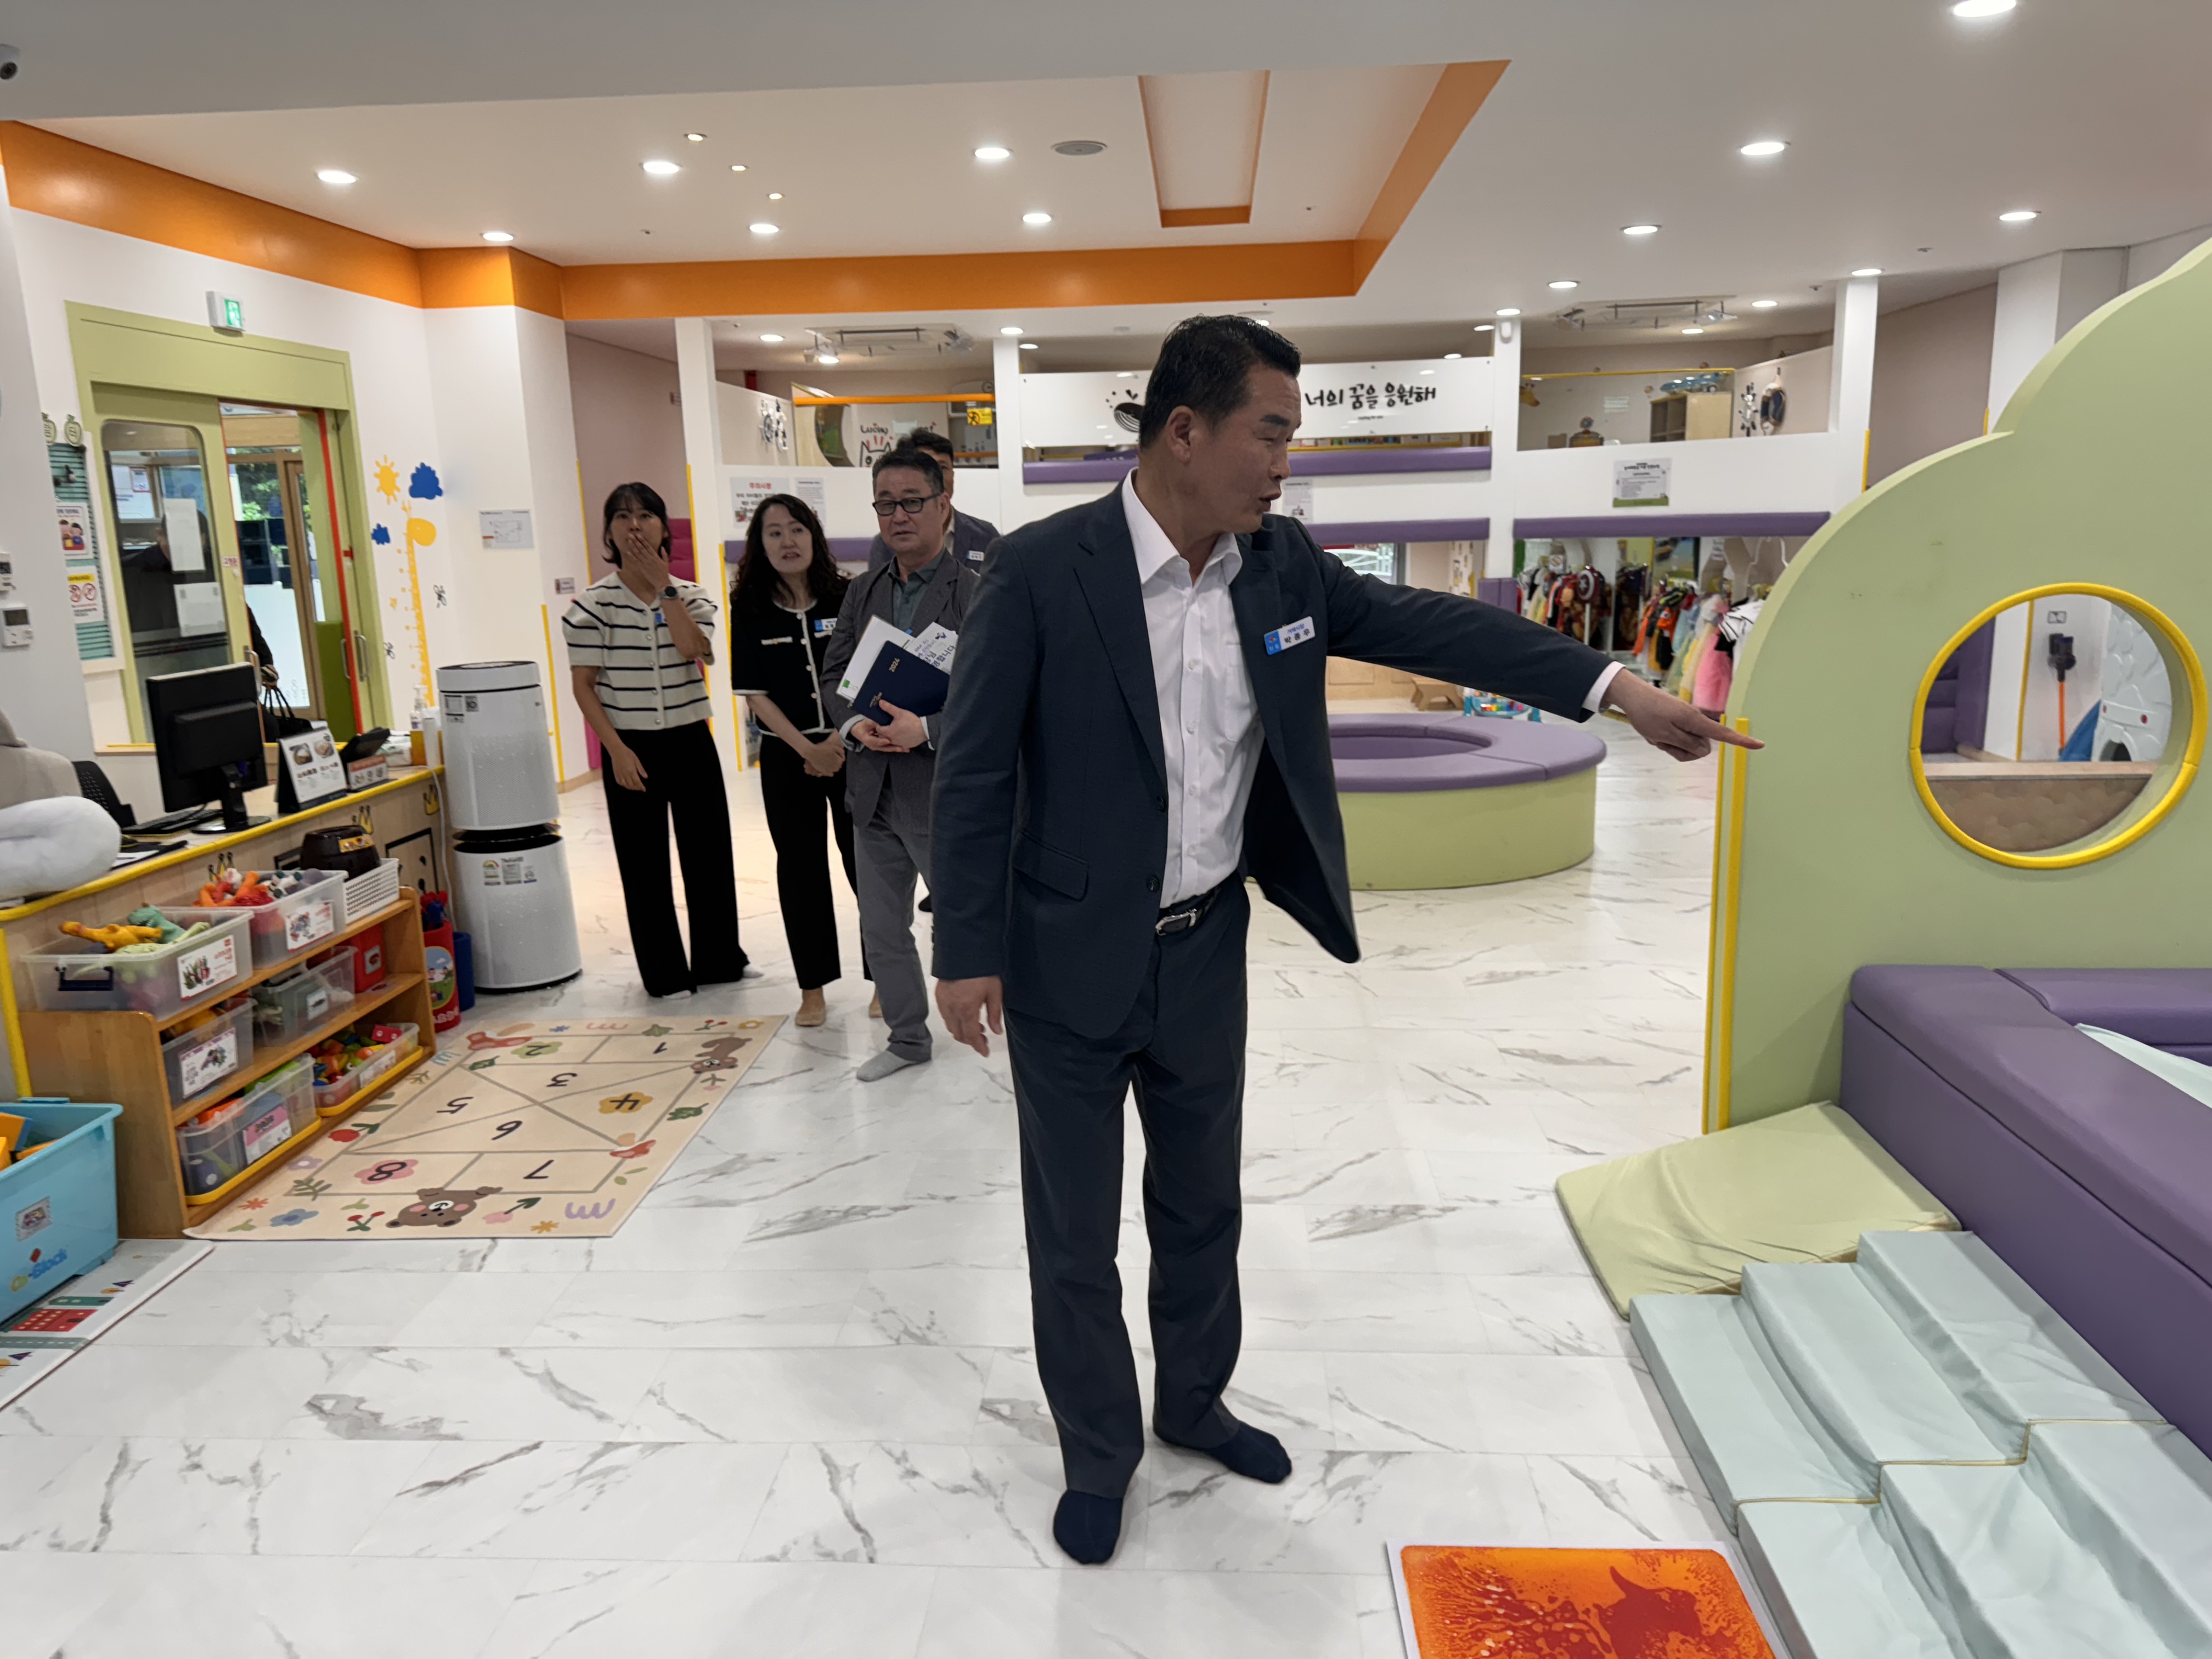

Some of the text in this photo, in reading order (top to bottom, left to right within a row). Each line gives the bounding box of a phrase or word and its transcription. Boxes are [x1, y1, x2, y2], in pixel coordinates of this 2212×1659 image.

[1305, 382, 1436, 410] 너의 꿈을 응원해
[889, 658, 900, 673] 2024
[437, 1097, 473, 1114] 5
[610, 1093, 640, 1111] 4
[367, 1161, 407, 1182] 8
[523, 1159, 554, 1180] 7
